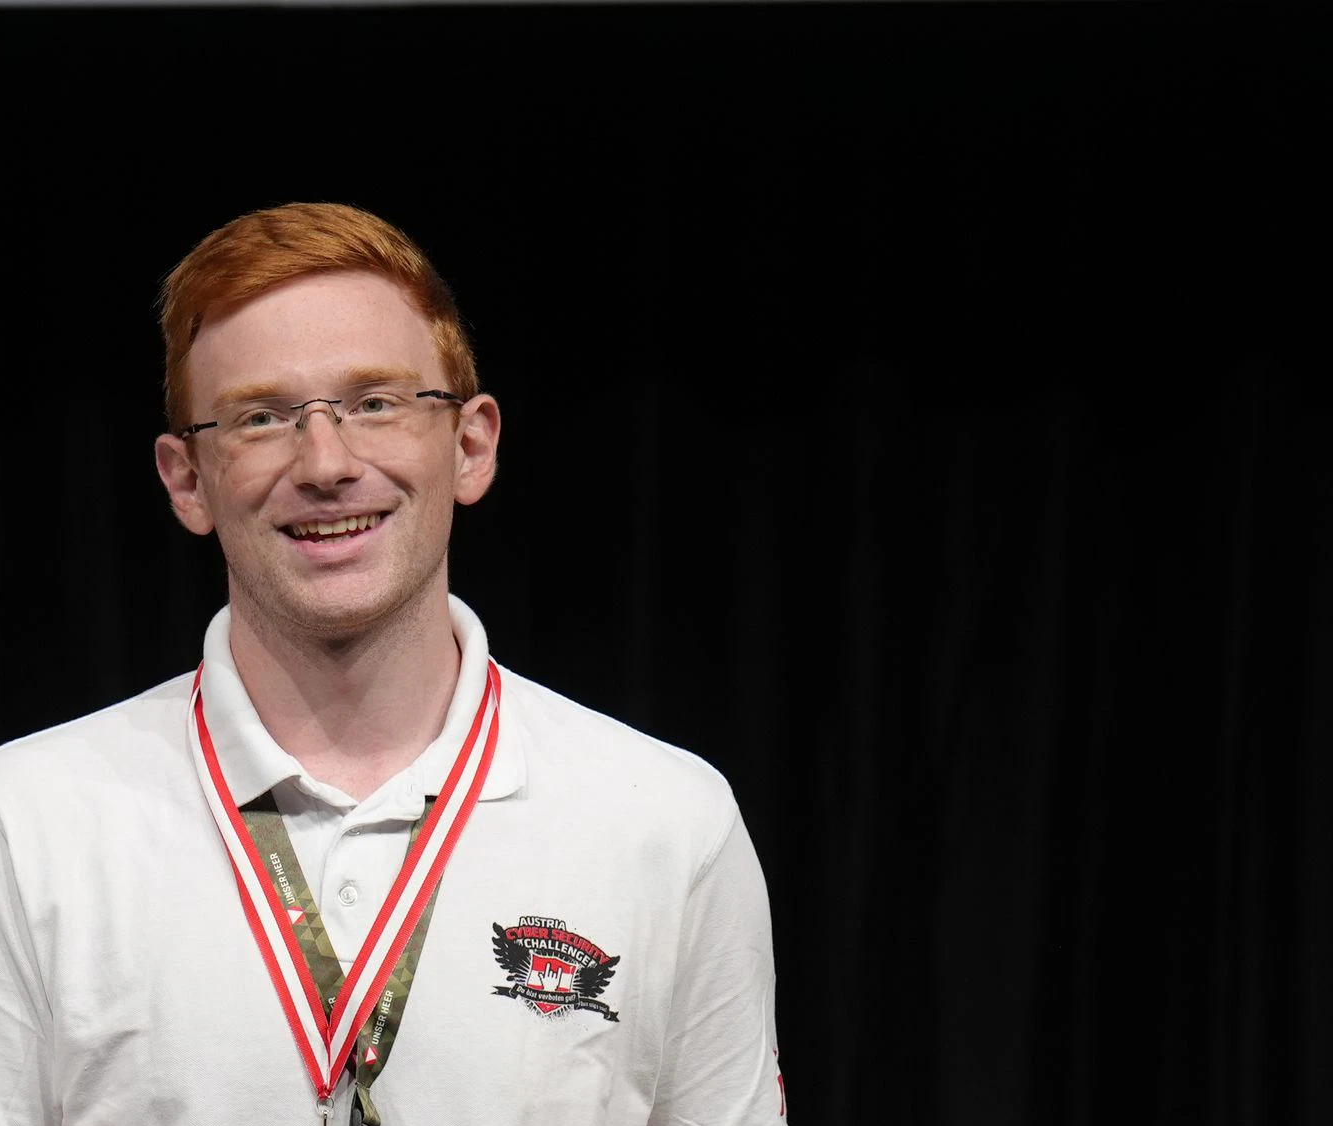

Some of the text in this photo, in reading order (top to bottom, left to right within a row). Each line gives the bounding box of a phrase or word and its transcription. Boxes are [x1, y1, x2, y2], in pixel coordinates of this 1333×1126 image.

[269, 852, 295, 905] UNSER HEER
[520, 917, 566, 930] AUSTRIA
[505, 927, 611, 965] CYBER SECURITY
[524, 938, 591, 968] CHALLENGE
[371, 990, 394, 1045] UNSER HEER
